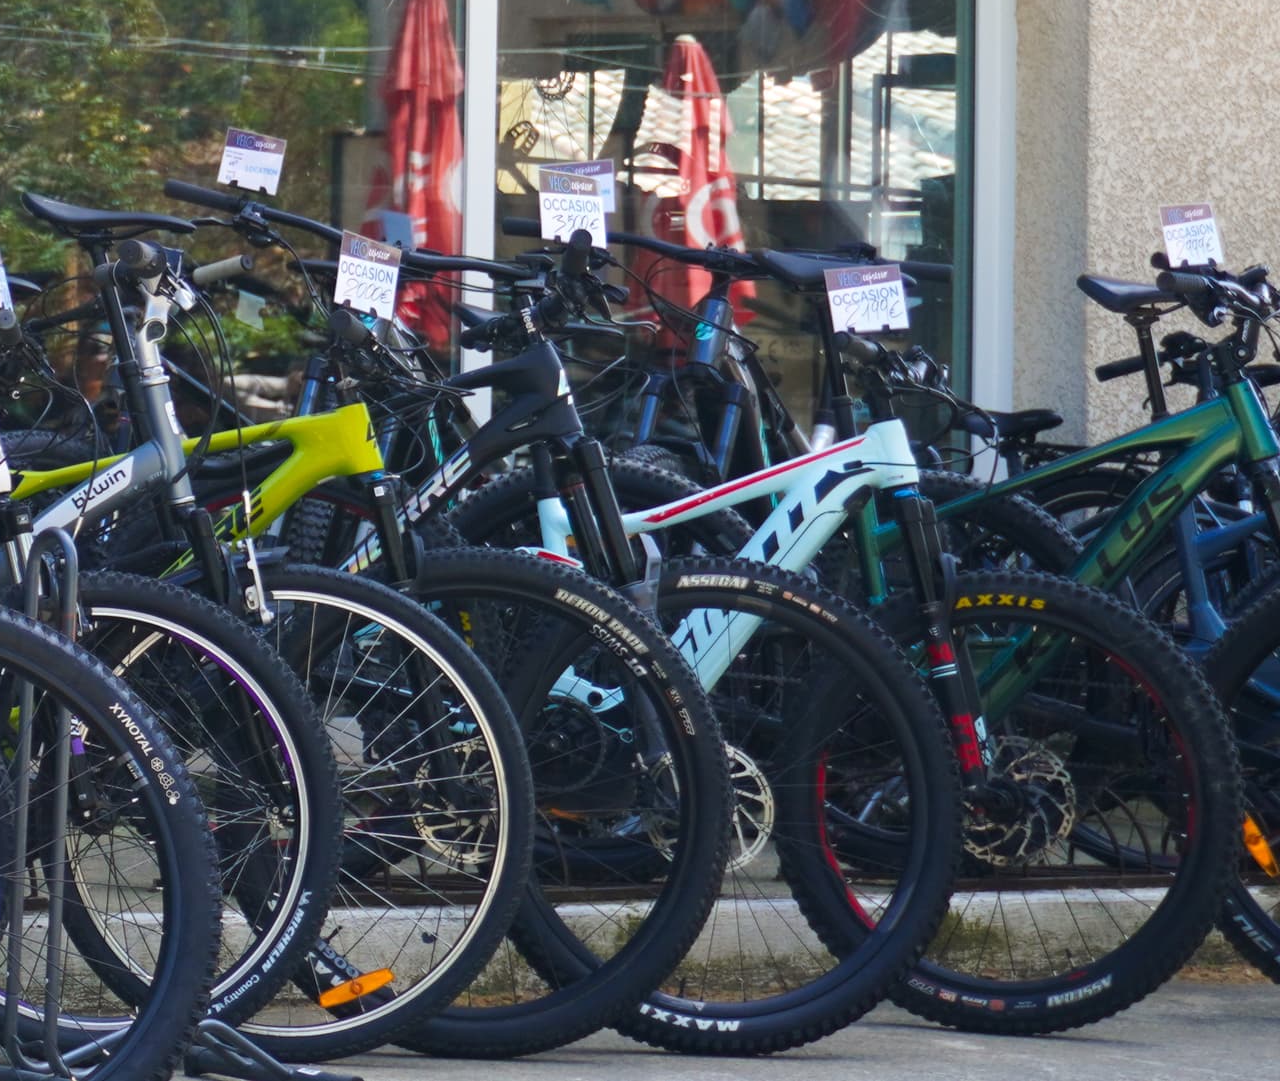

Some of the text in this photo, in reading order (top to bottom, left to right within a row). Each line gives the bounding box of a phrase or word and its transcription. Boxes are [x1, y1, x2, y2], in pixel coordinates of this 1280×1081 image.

[543, 198, 600, 213] OCCASION
[1166, 224, 1214, 241] OCCASION
[341, 261, 394, 284] OCCASION
[832, 286, 899, 306] OCCASION
[954, 594, 1046, 609] AXXIS
[590, 624, 629, 658] SWISS
[625, 655, 648, 677] DT
[108, 702, 154, 757] XYNOTAL
[261, 908, 305, 973] MICHELIN
[223, 975, 260, 1007] Country
[639, 1003, 740, 1032] MAXXI
